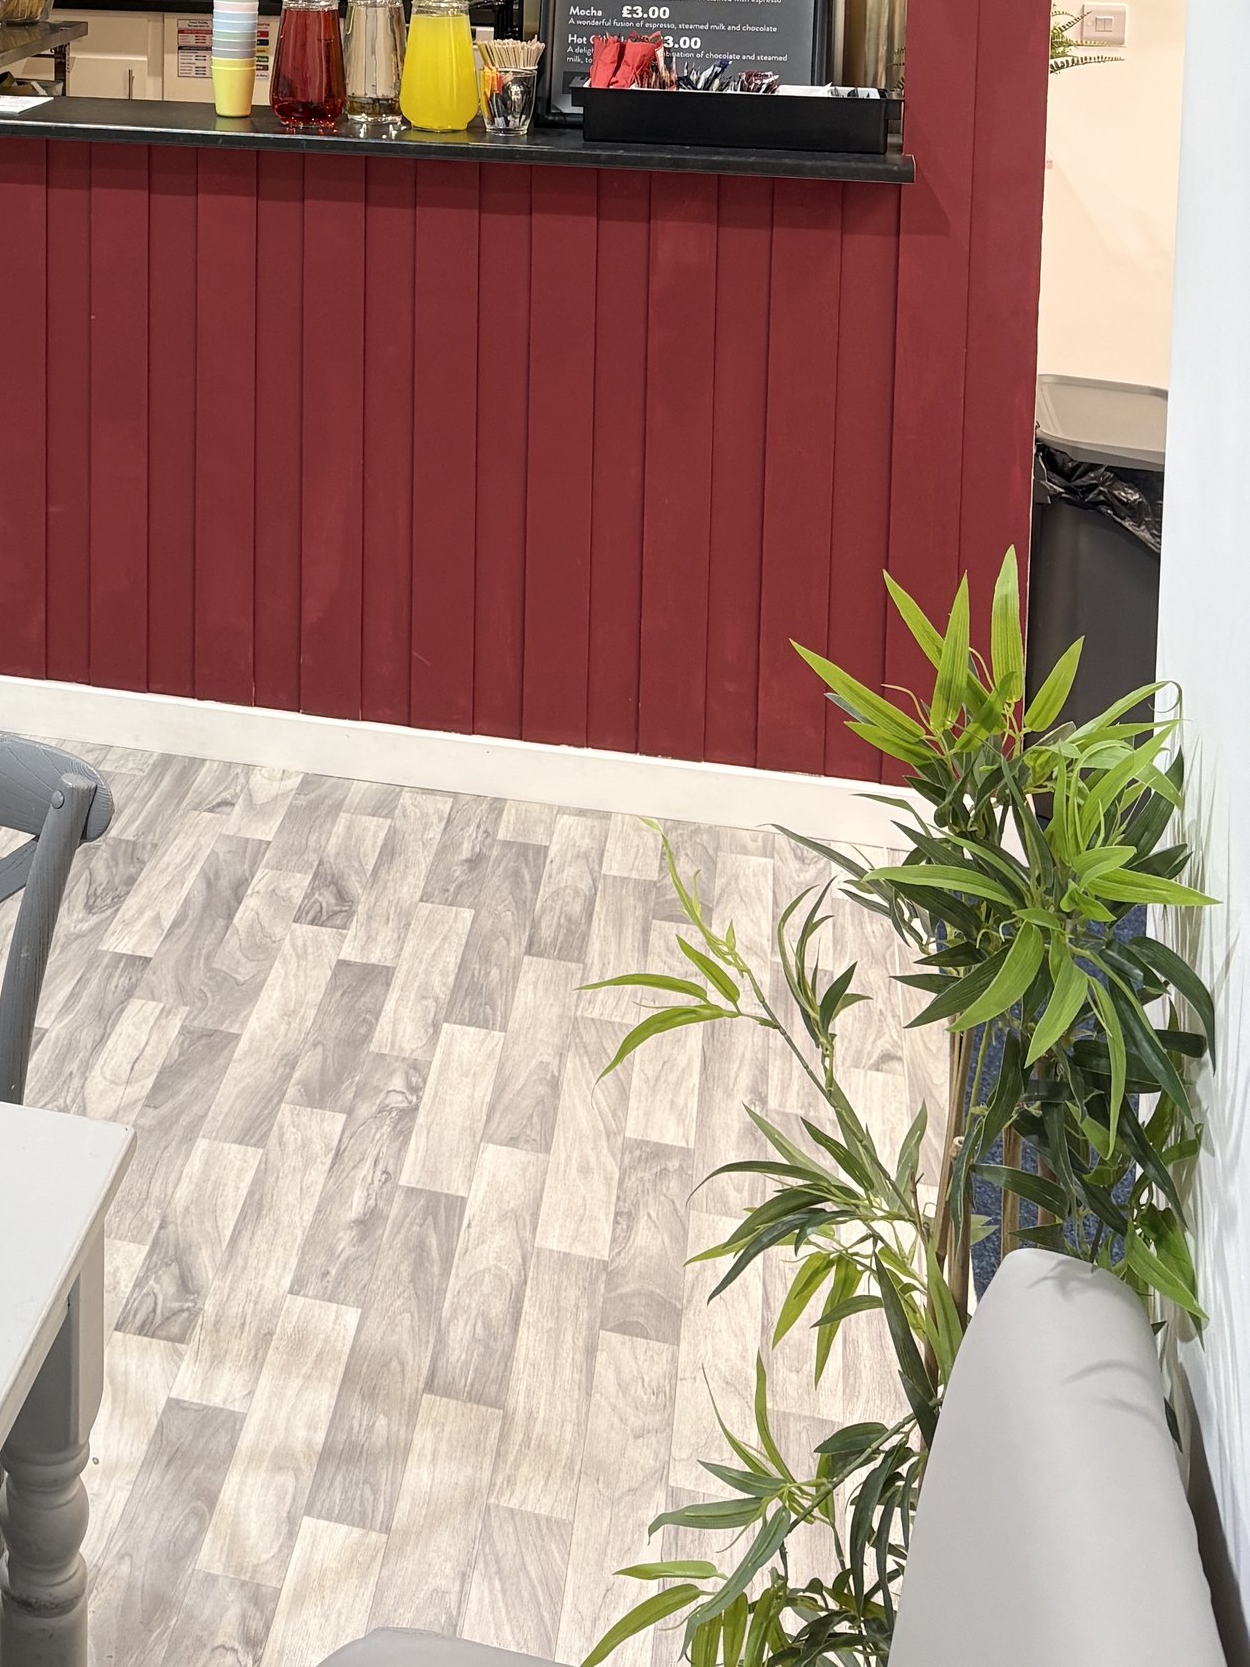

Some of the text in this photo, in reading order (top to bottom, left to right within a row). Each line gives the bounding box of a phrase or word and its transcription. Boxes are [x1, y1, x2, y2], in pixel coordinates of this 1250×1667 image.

[569, 5, 670, 19] Mocha £3.00
[568, 17, 575, 25] A
[576, 18, 611, 27] wonderful
[613, 19, 634, 27] fusion
[645, 22, 677, 30] espresso,
[710, 23, 726, 31] milk
[742, 24, 778, 32] chocolate
[568, 34, 587, 44] Hot
[663, 36, 701, 49] 3.00
[705, 52, 740, 60] chocolate
